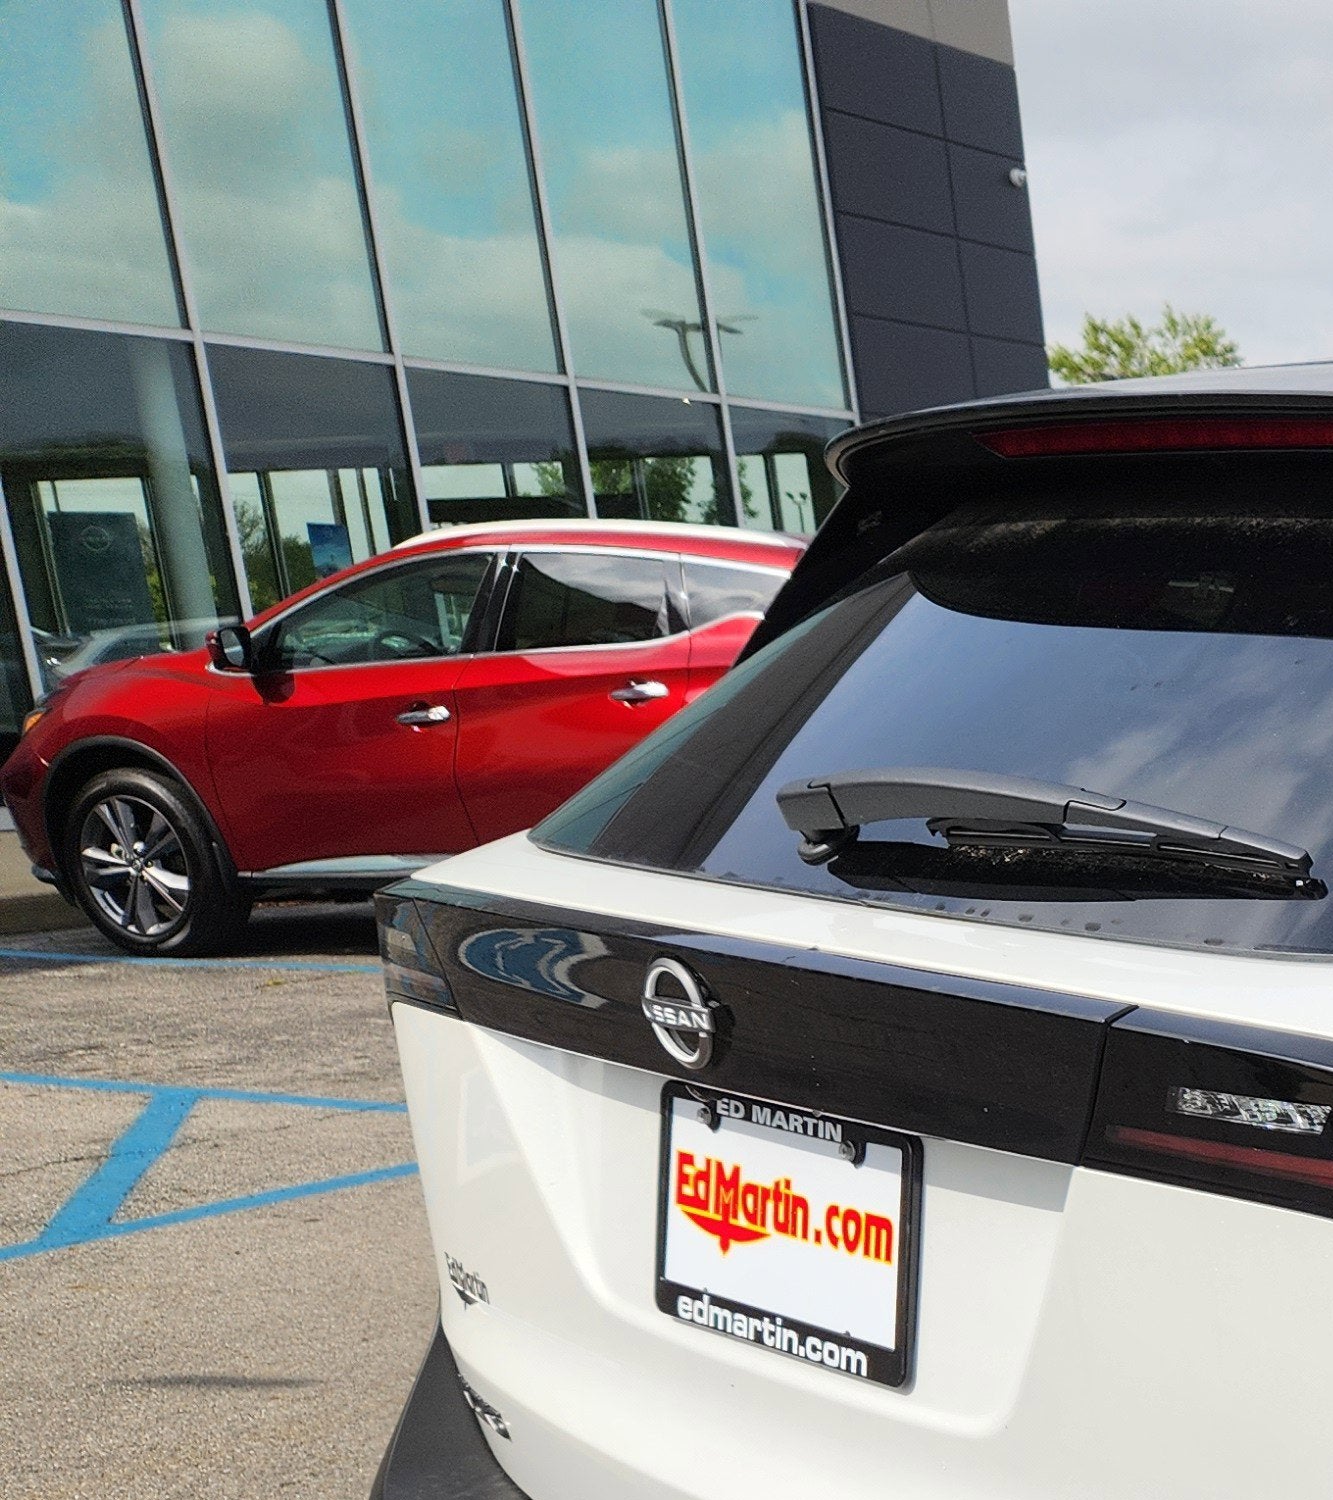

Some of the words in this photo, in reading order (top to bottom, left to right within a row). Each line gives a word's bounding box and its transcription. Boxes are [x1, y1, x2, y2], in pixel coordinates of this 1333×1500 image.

[715, 1098, 745, 1120] ED
[751, 1105, 843, 1143] MARTIN
[676, 1293, 868, 1377] edmartin.com
